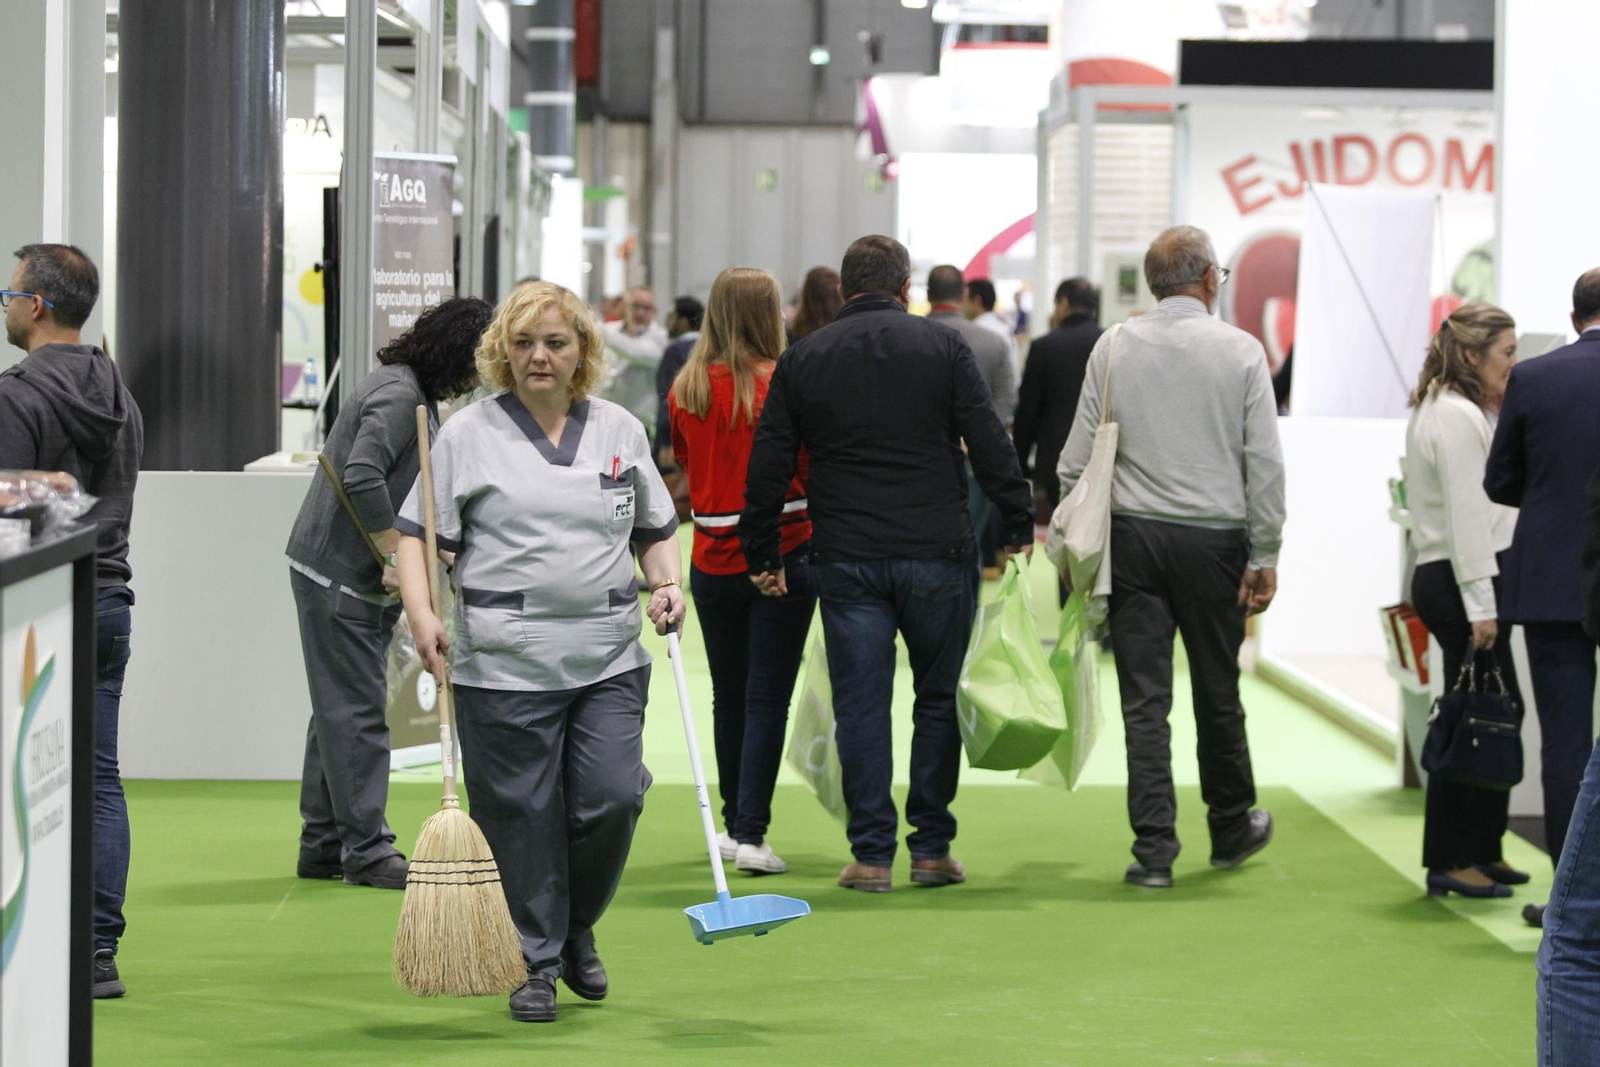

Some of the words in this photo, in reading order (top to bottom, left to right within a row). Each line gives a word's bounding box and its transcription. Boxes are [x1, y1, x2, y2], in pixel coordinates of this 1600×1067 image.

[1219, 132, 1494, 217] EJIDOM
[389, 173, 426, 204] AGQ
[373, 268, 420, 286] laboratorio
[423, 272, 445, 290] para
[376, 289, 422, 311] agricultura
[424, 290, 440, 308] del
